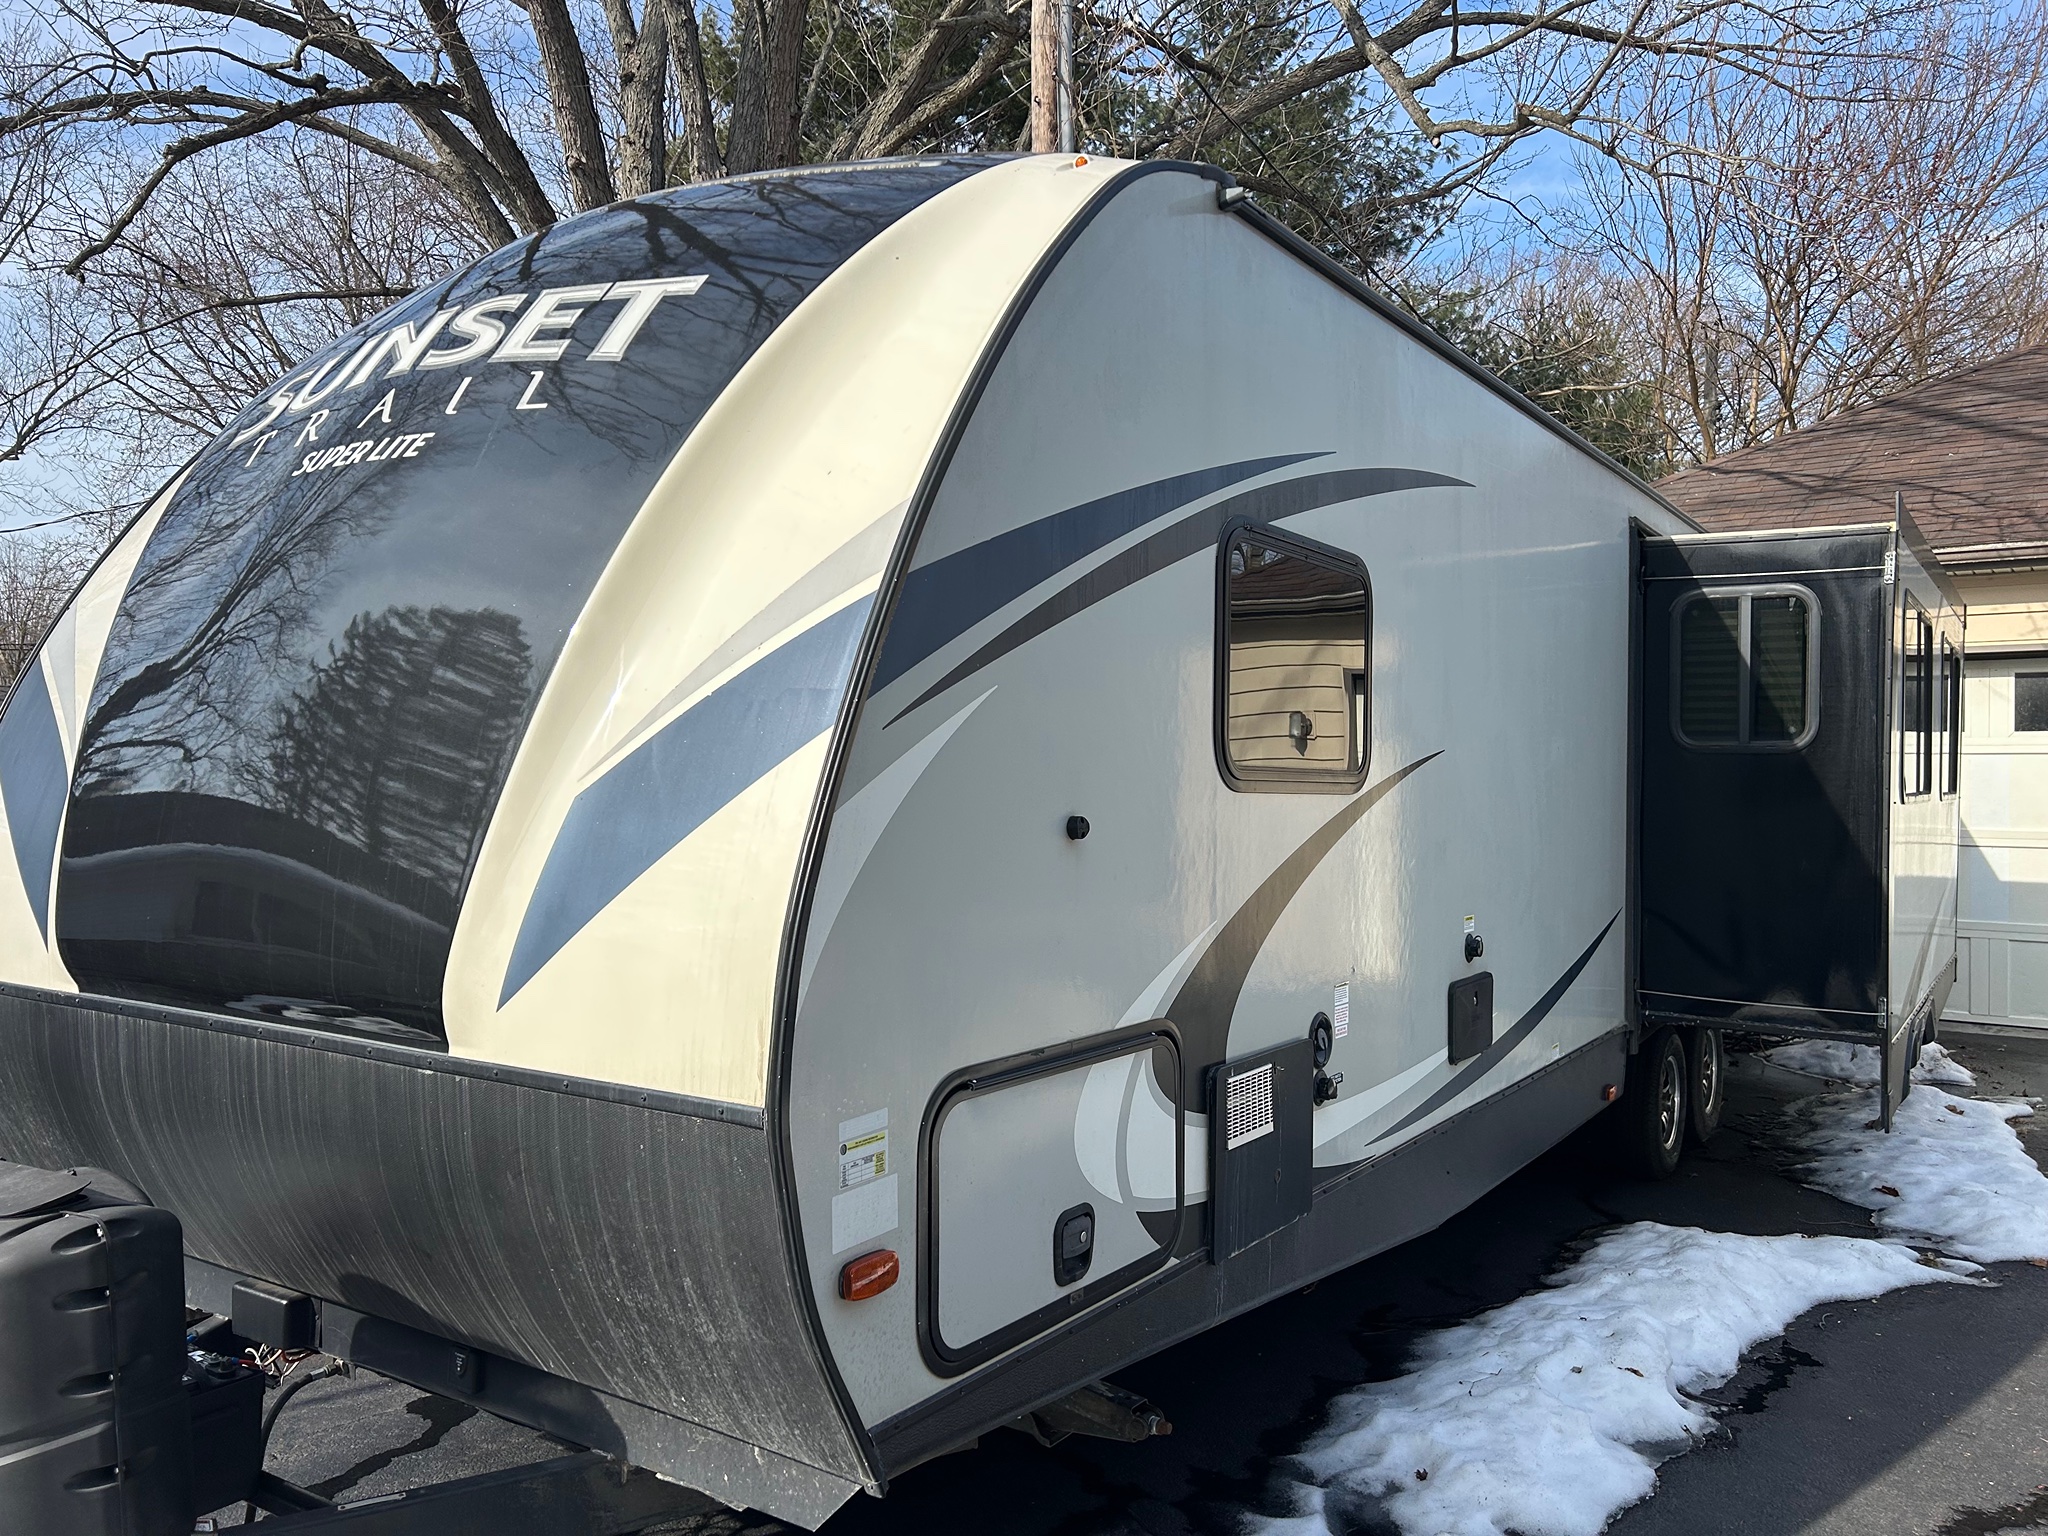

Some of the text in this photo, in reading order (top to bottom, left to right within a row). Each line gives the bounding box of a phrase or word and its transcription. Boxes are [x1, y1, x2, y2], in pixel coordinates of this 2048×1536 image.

[225, 274, 709, 452] SUNSET
[244, 370, 549, 468] TRAIL
[291, 432, 436, 477] SUPER LITE
